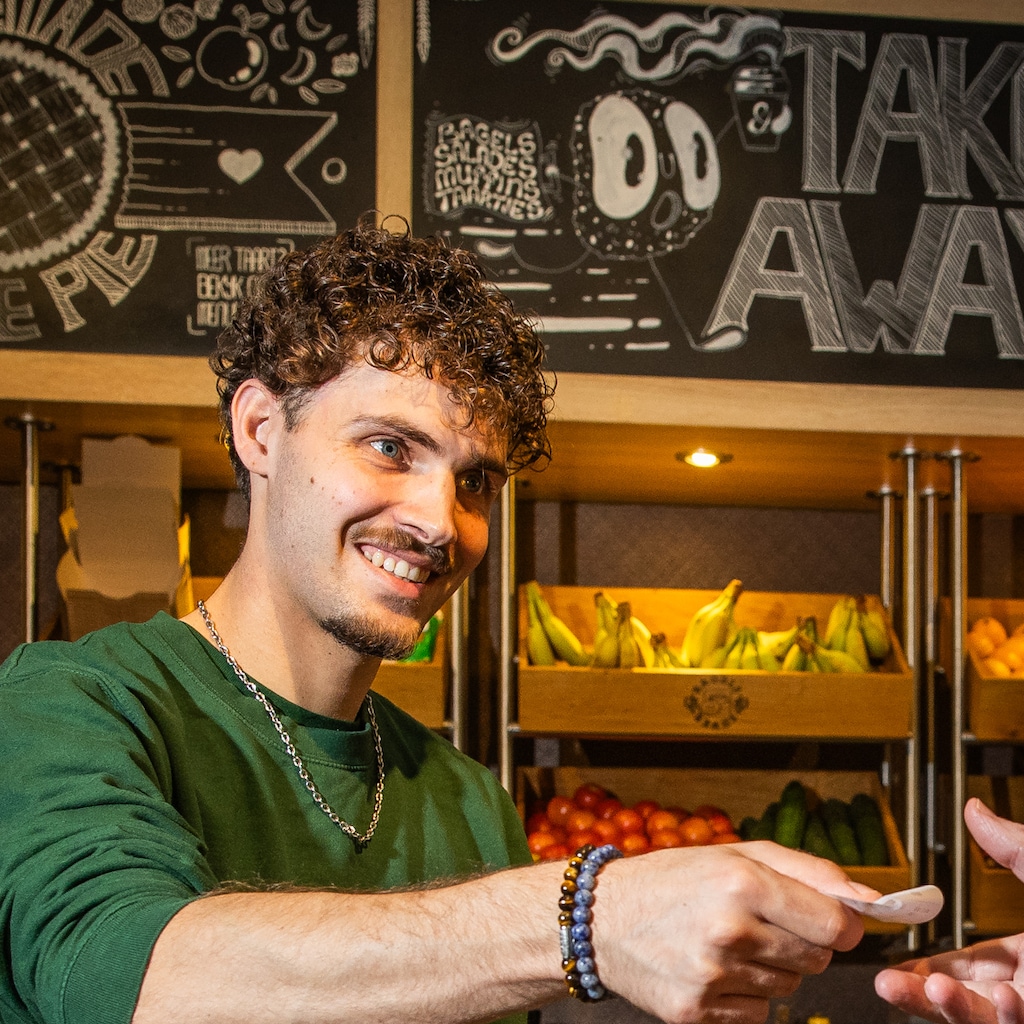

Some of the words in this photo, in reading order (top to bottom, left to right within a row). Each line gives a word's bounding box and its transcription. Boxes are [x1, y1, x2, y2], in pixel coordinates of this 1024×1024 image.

[437, 118, 537, 156] BAGELS
[434, 140, 538, 179] SALADES
[435, 163, 541, 201] MUFFINS
[39, 231, 158, 333] PIE
